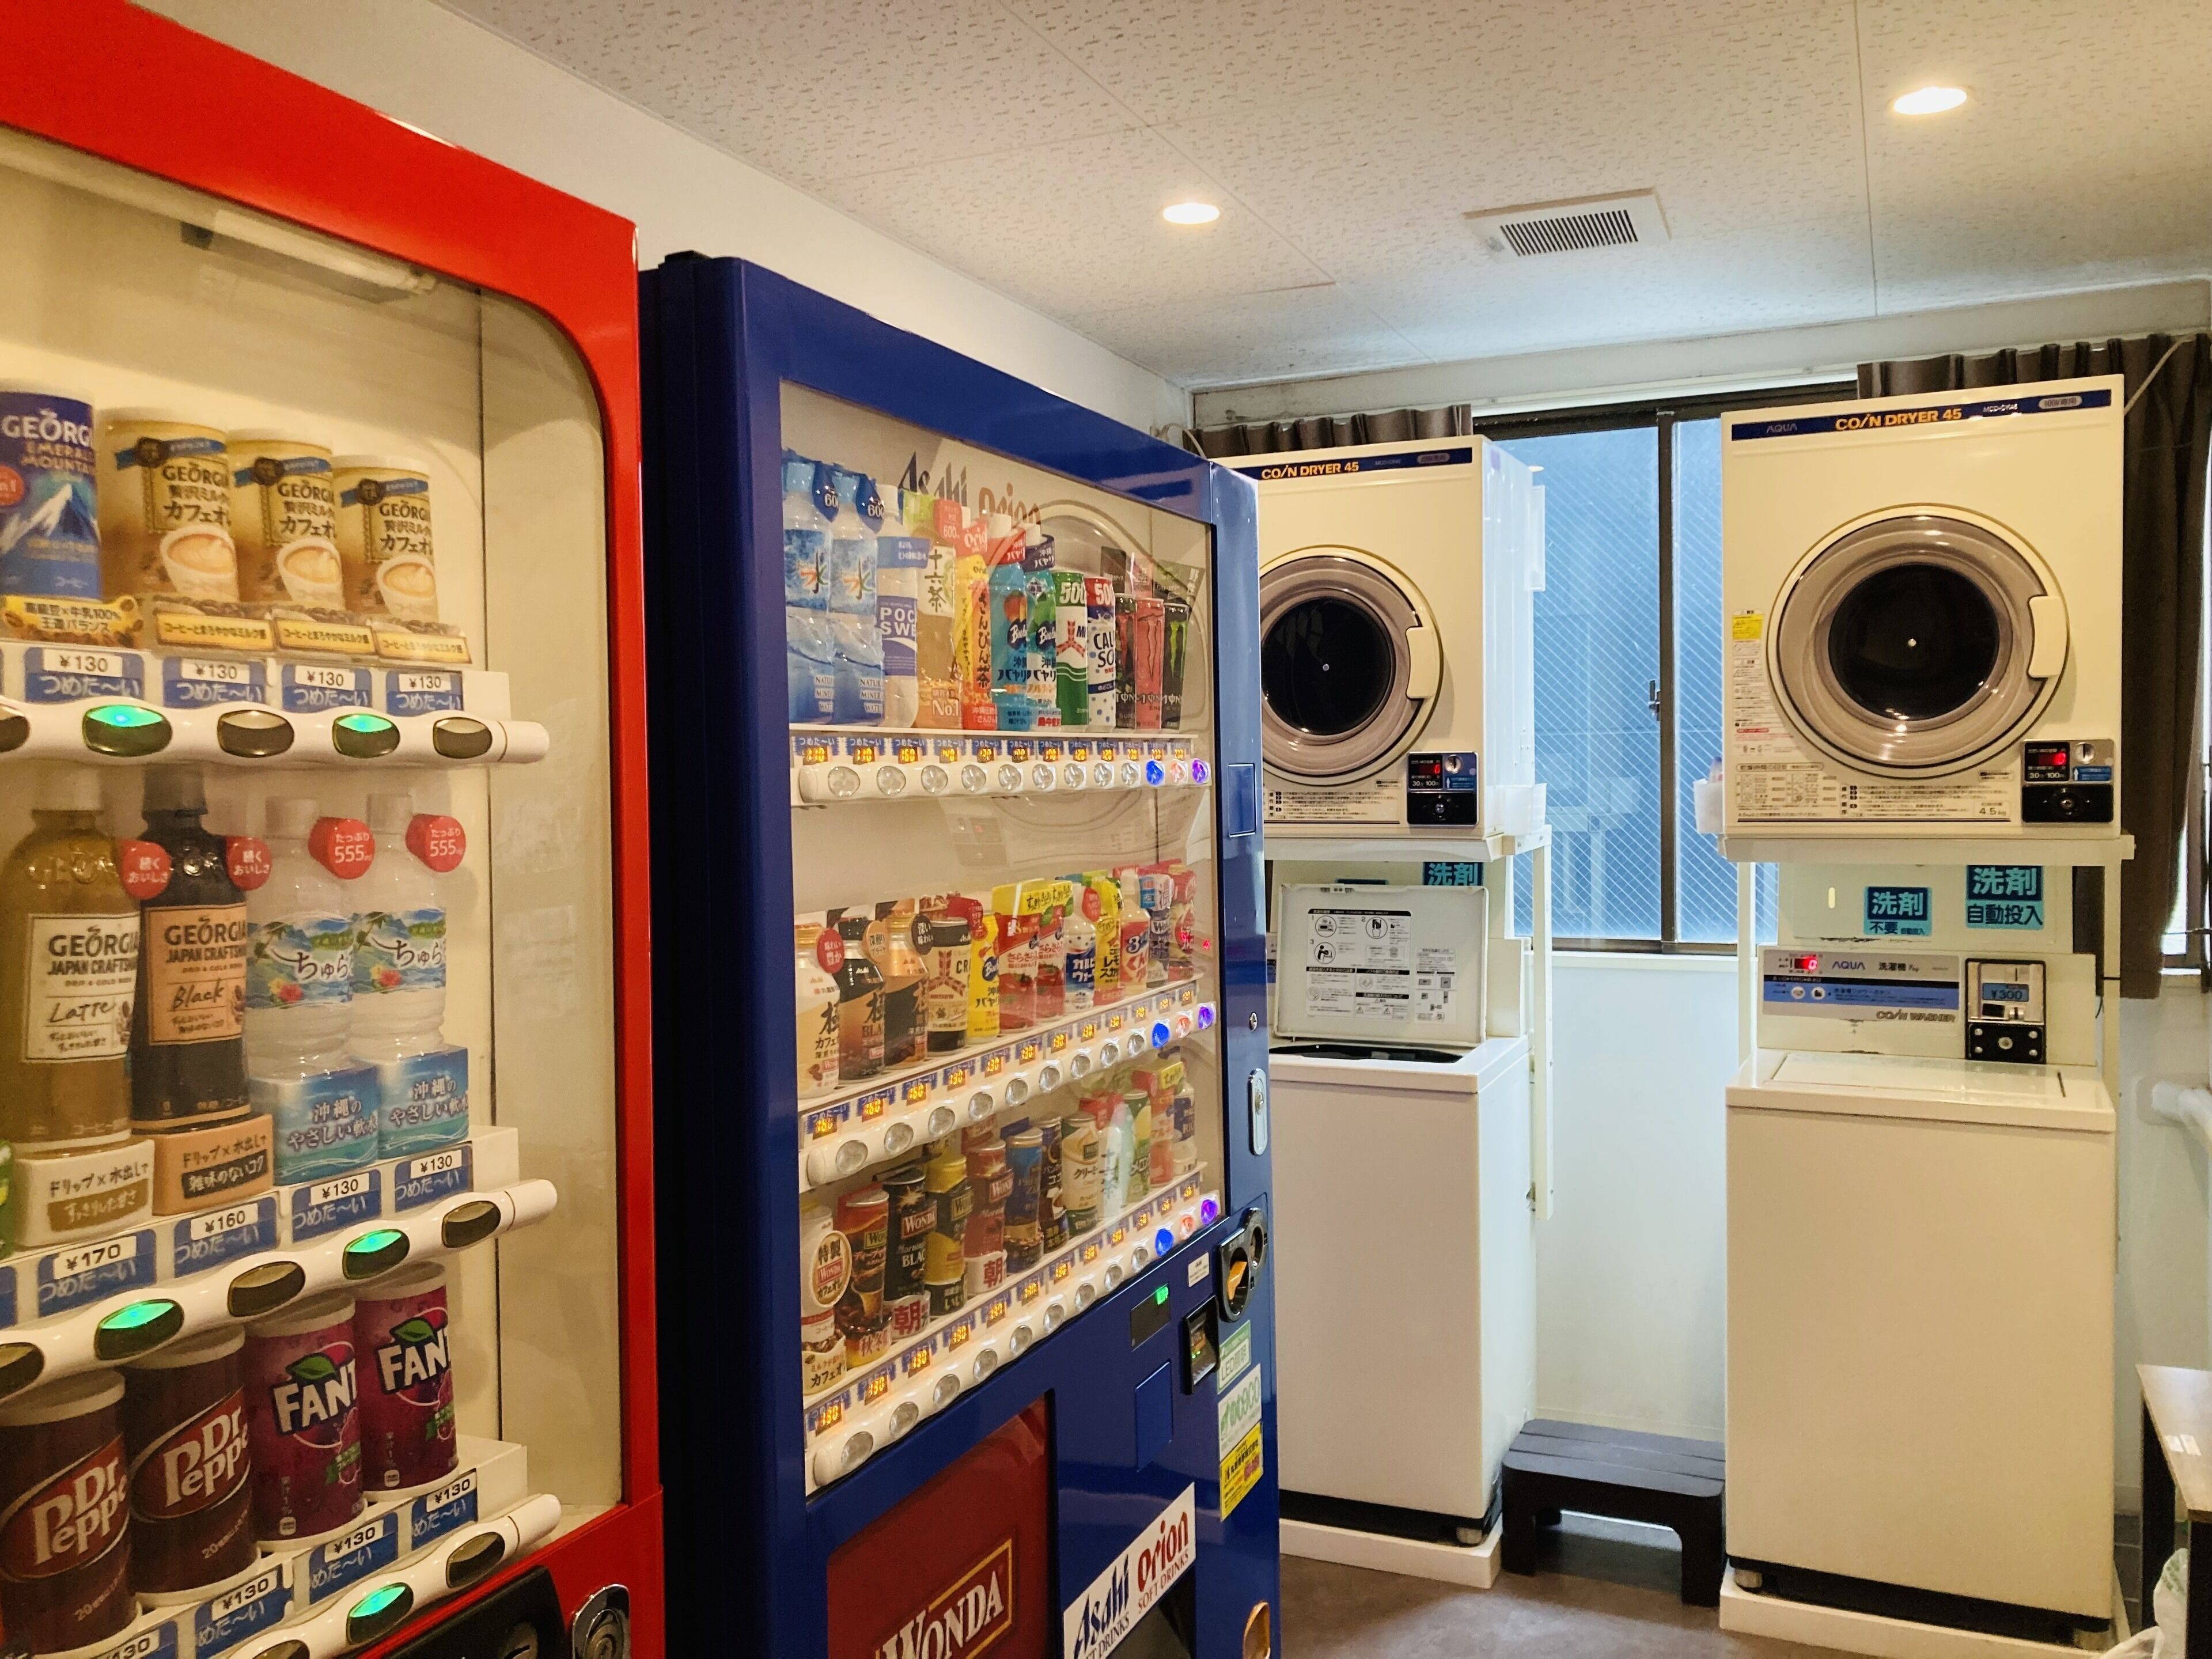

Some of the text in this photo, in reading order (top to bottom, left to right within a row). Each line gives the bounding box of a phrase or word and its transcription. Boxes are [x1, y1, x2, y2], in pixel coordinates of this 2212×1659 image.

[1885, 408, 1938, 427] DRYER
[1942, 408, 1962, 422] 45
[1300, 461, 1341, 477] DRYER
[1344, 460, 1359, 473] 45
[925, 549, 946, 612] 十六茶
[880, 607, 916, 623] POC
[880, 621, 916, 637] SWE
[1093, 631, 1113, 650] CAL
[59, 654, 108, 672] ¥130
[1097, 649, 1115, 668] SO
[195, 663, 238, 679] ¥130
[306, 670, 344, 687] ¥130
[408, 675, 441, 690] ¥130
[1428, 862, 1478, 886] 洗剤
[1973, 866, 2037, 896] 洗剤
[1871, 892, 1923, 916] 洗剤
[1967, 904, 2043, 926] 自動投入
[1869, 922, 1899, 935] 不要
[1832, 960, 1866, 970] AQUA
[172, 978, 225, 1012] Black
[1990, 990, 2022, 1000] ¥300
[412, 1077, 456, 1100] 沖縄の
[313, 1097, 362, 1122] 沖縄の
[421, 1155, 453, 1173] ¥130
[321, 1179, 358, 1199] ¥130
[204, 1210, 247, 1233] ¥160
[66, 1244, 121, 1271] ¥170
[894, 1300, 921, 1336] 朝
[273, 1358, 358, 1433] FANT
[202, 1406, 241, 1461] Dr
[73, 1457, 119, 1517] Dr
[434, 1478, 471, 1504] ¥130
[334, 1527, 376, 1554] ¥130
[222, 1578, 269, 1610] ¥130
[1138, 1552, 1189, 1613] SOFT DRINKS
[882, 1570, 1004, 1659] WONDA
